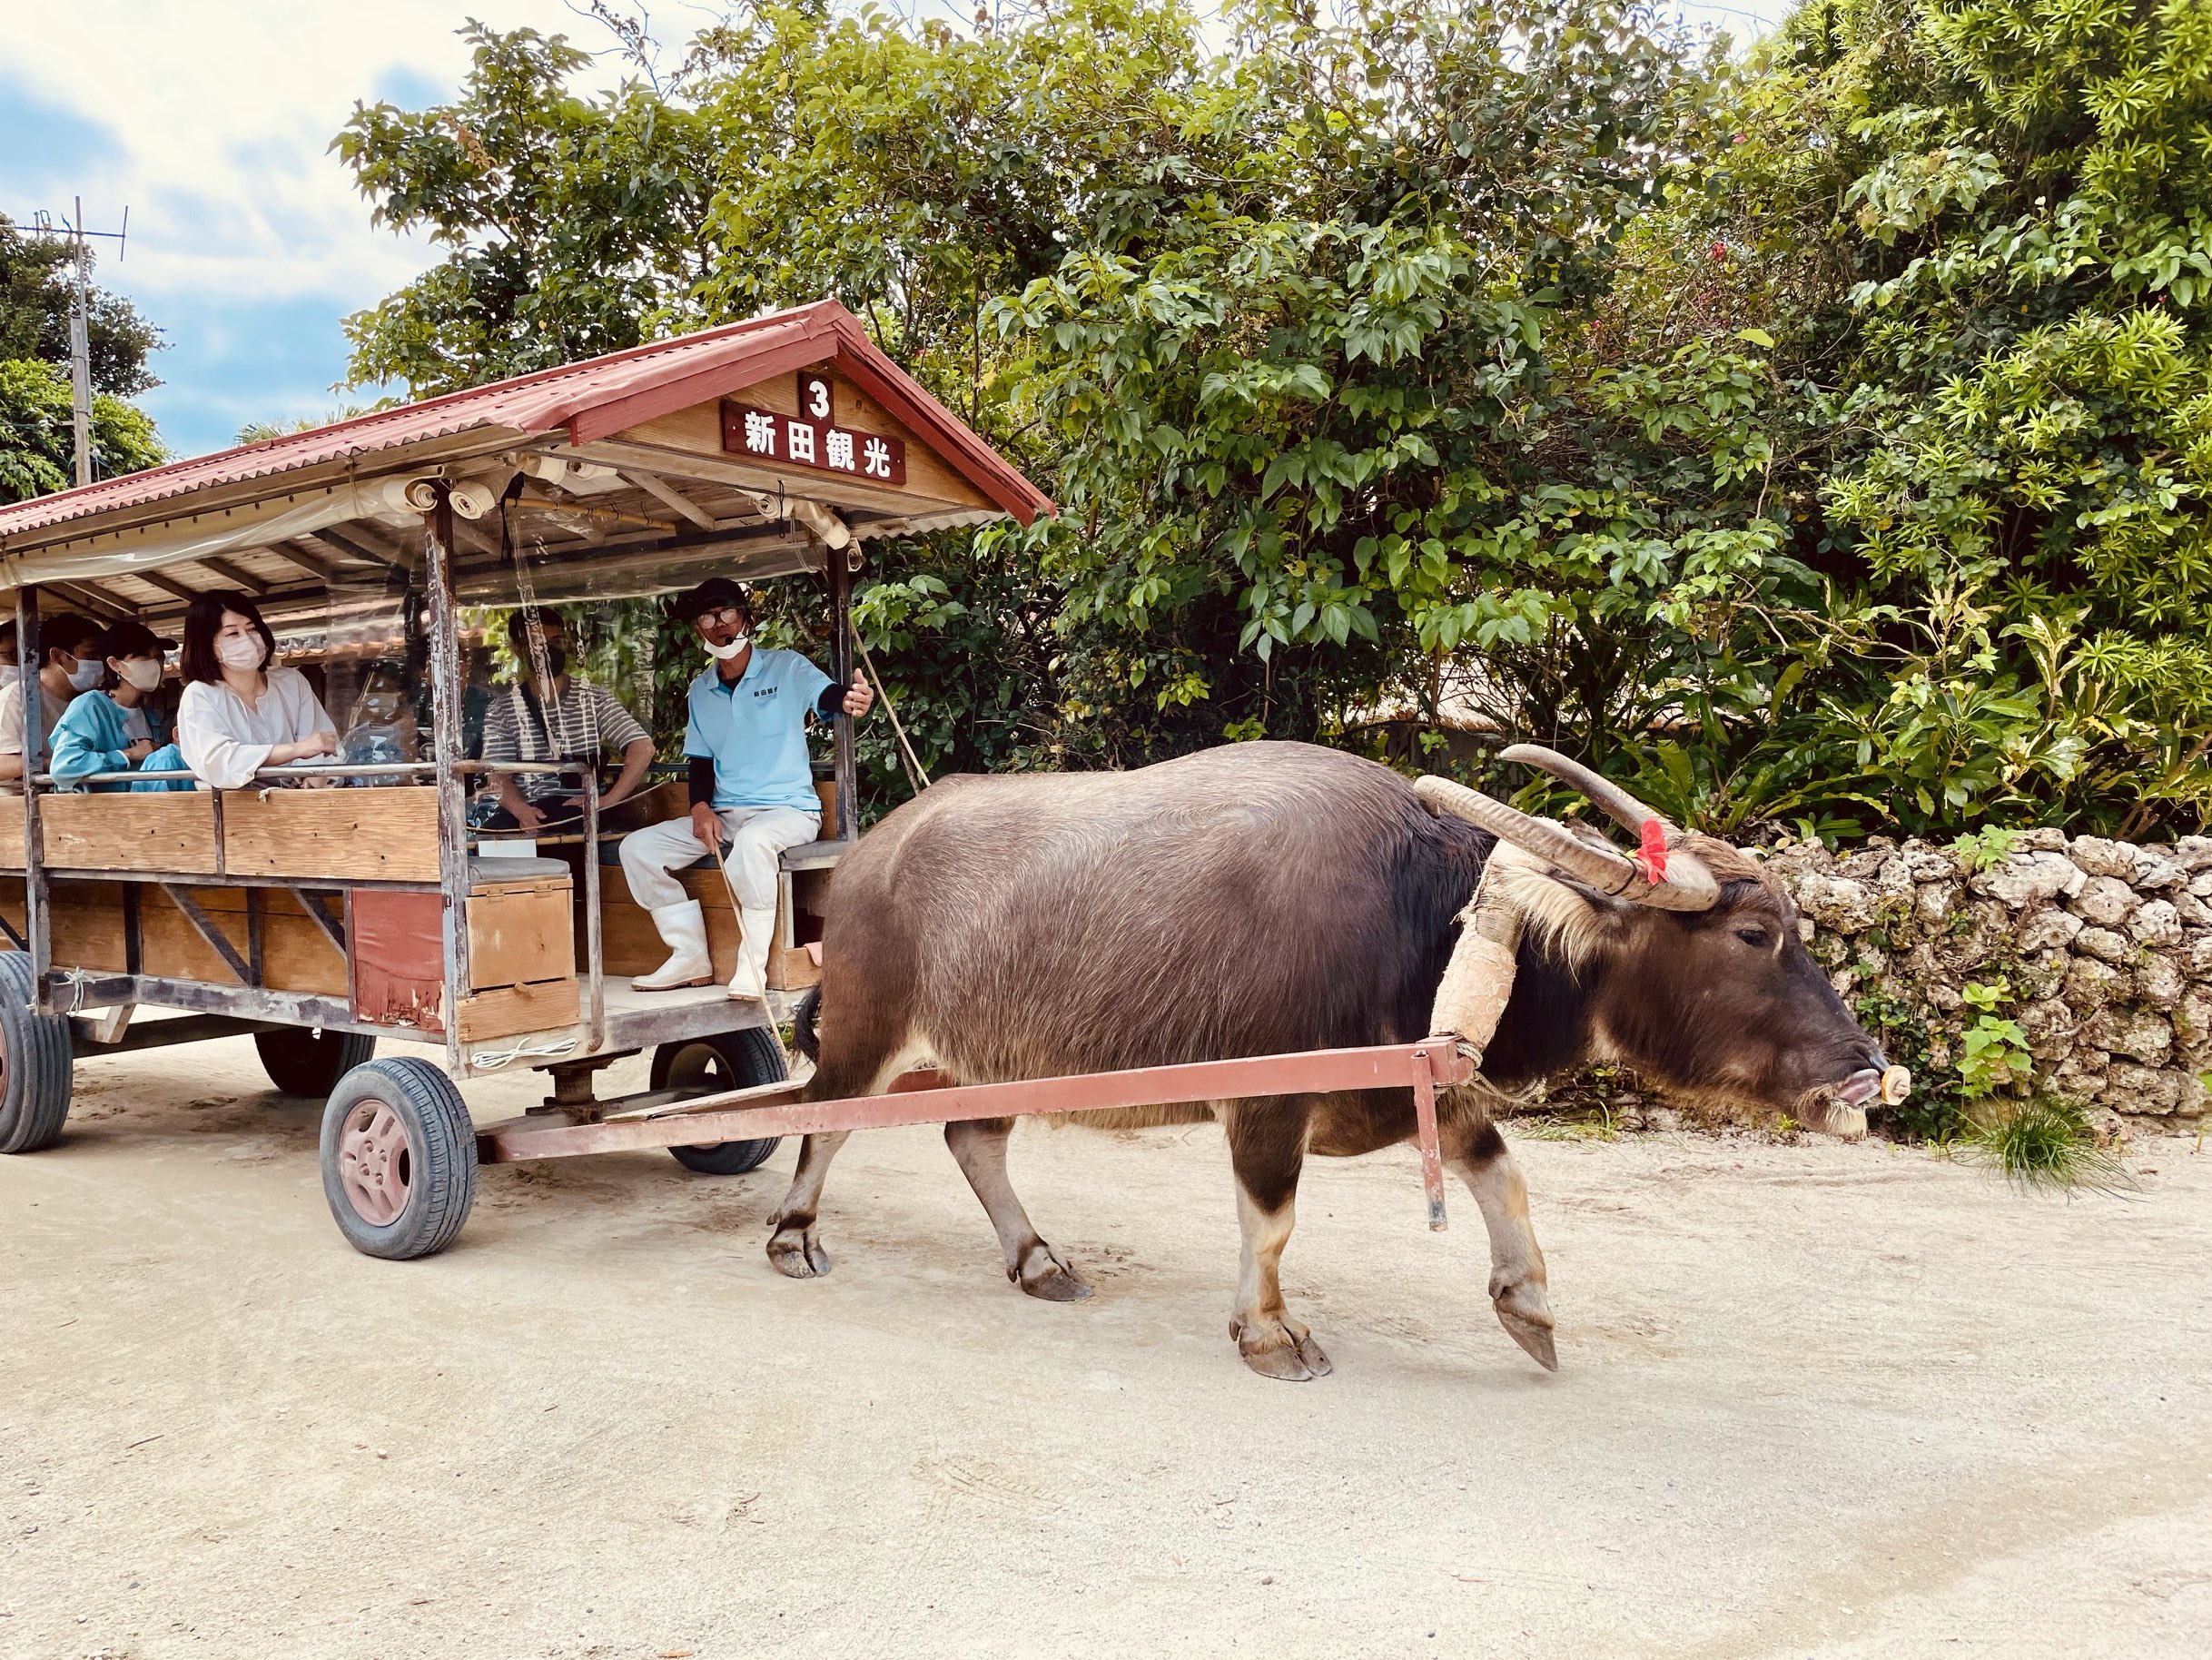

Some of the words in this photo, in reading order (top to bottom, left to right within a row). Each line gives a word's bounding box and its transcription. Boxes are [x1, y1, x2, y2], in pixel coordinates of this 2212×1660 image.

[809, 380, 830, 418] 3
[745, 411, 891, 478] 新田観光
